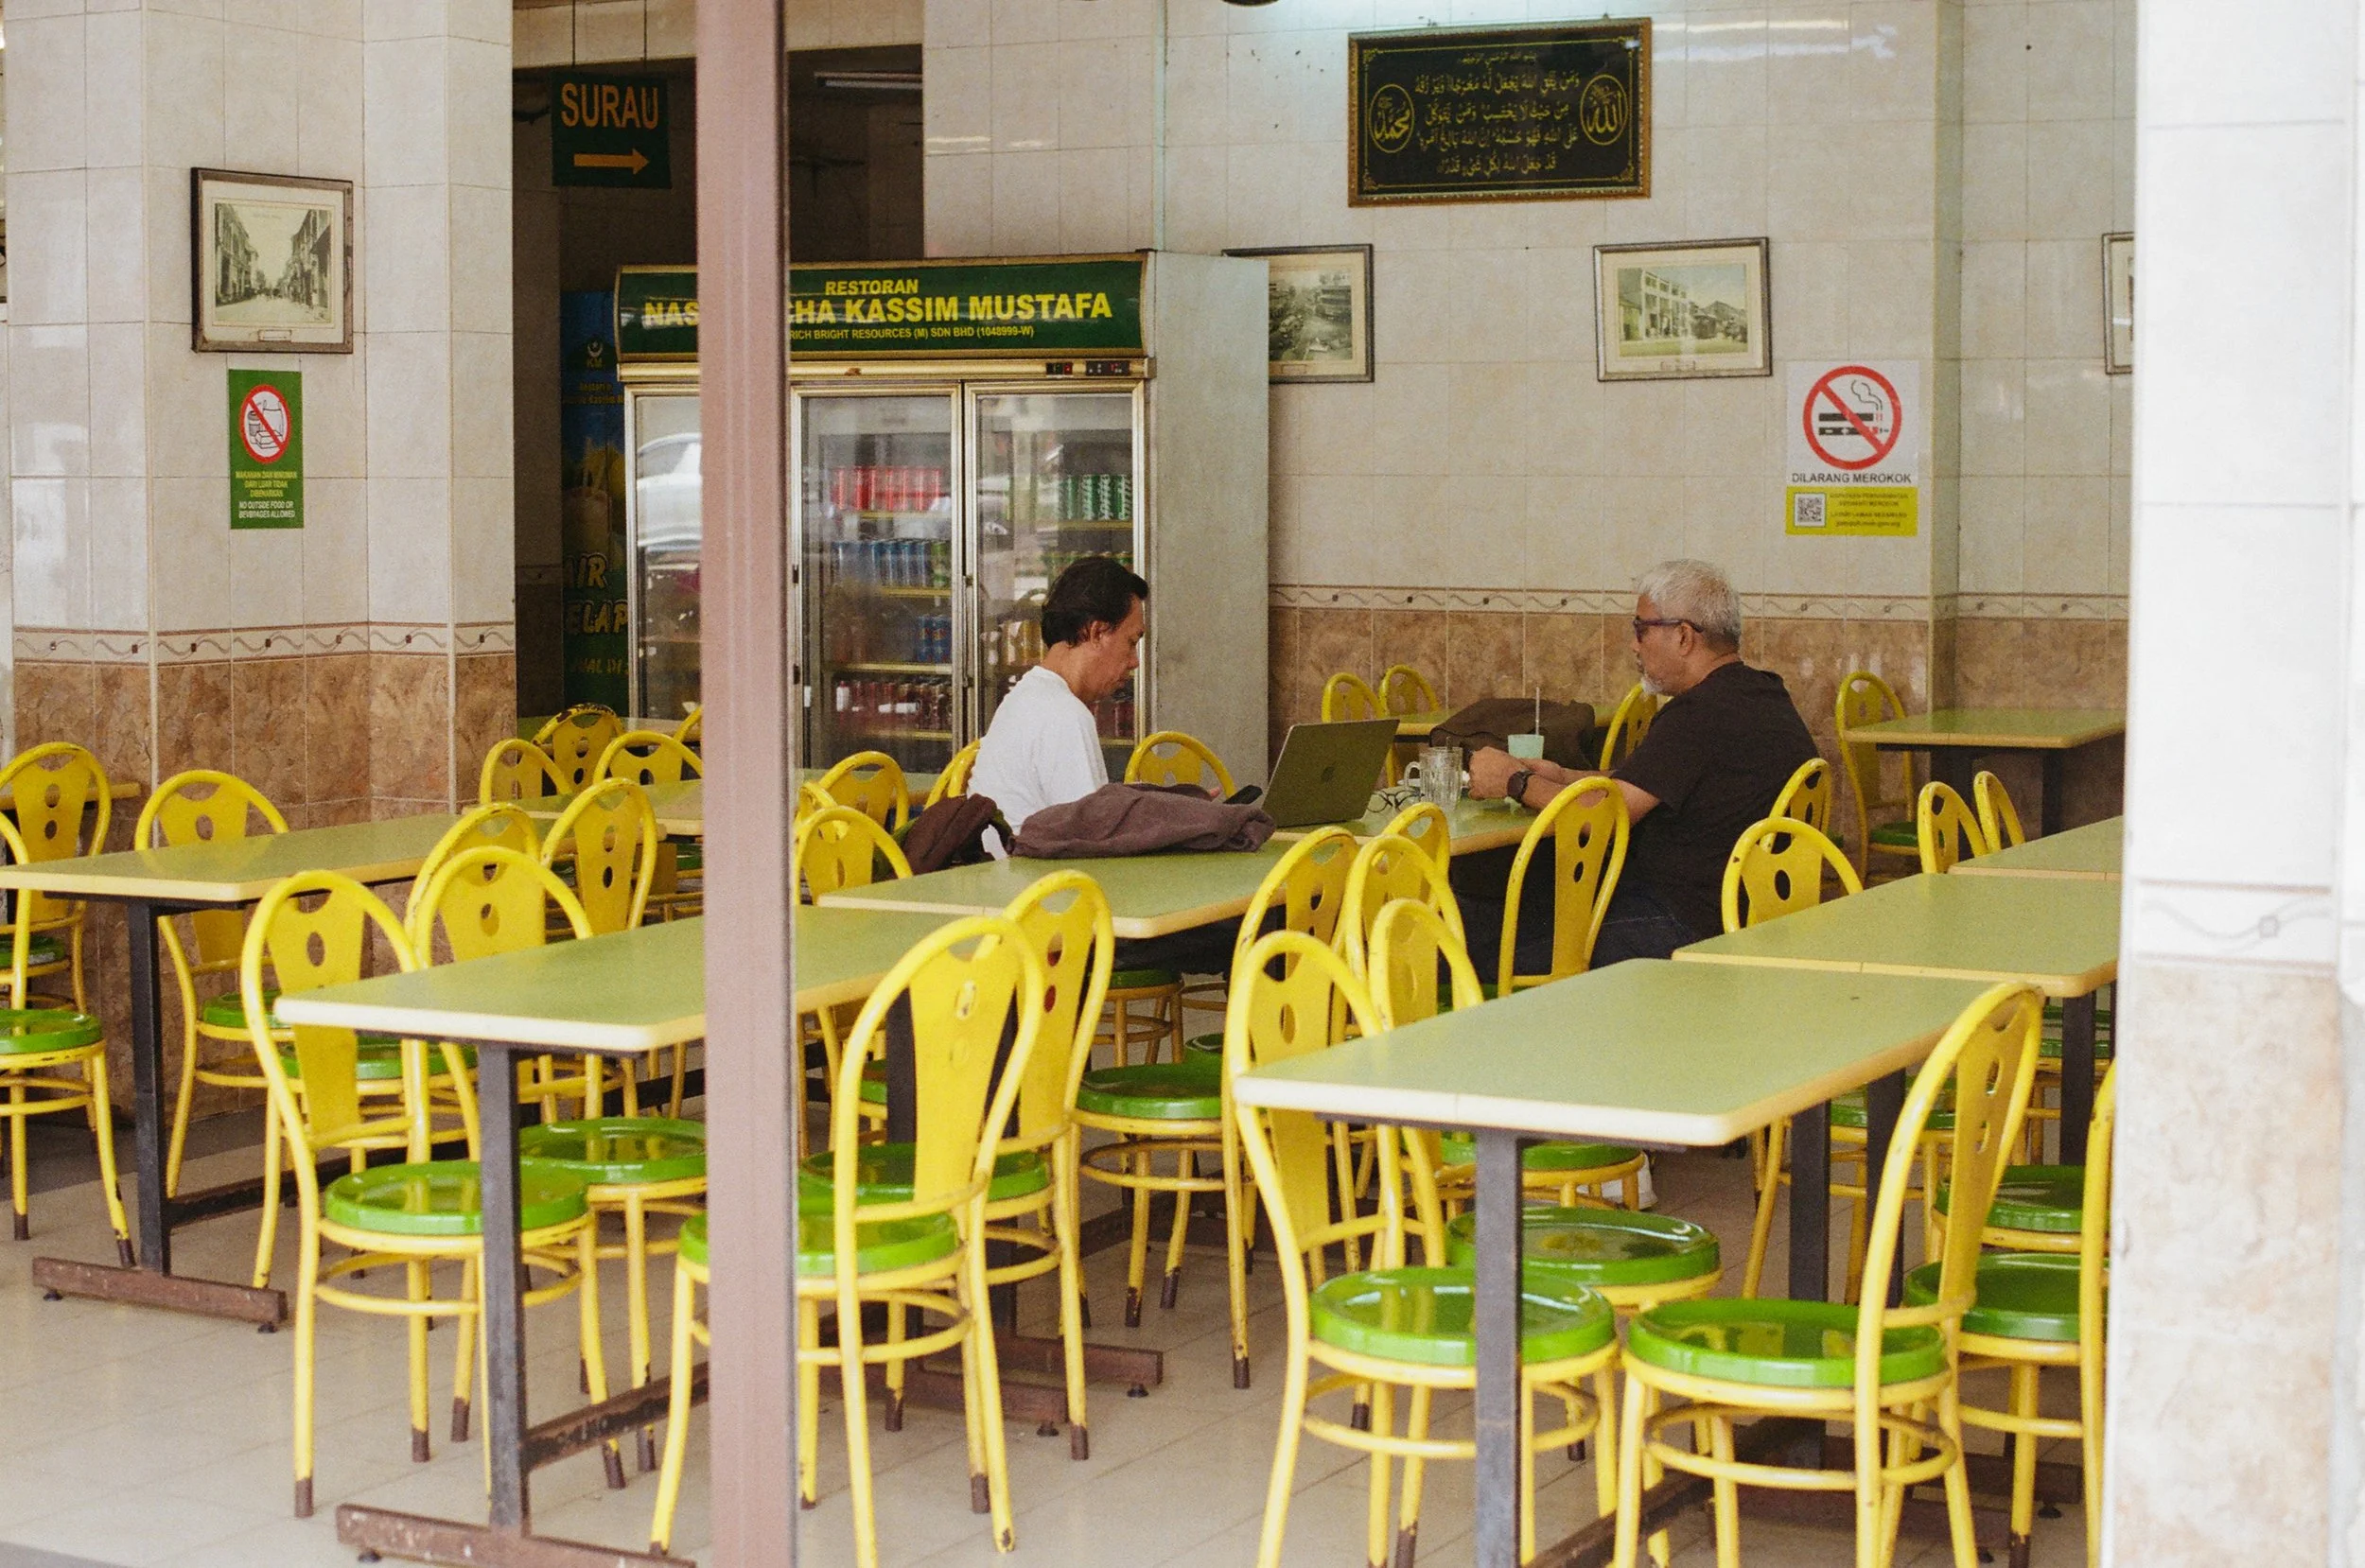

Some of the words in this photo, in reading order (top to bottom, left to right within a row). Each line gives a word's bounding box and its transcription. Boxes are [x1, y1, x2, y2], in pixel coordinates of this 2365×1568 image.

[561, 82, 659, 130] SURAU
[825, 279, 919, 295] RESTORAN
[643, 300, 698, 326] NAS
[845, 295, 958, 323] KASSIM
[969, 292, 1112, 322] MUSTAFA
[815, 329, 850, 340] BRIGHT
[853, 327, 911, 339] RESOURCES
[914, 327, 929, 340] (M)
[931, 327, 951, 338] SDN
[954, 326, 974, 337] BHD
[1792, 473, 1850, 483] DILARANG
[1852, 473, 1912, 483] MEROKOK
[238, 500, 247, 509] NO
[248, 500, 270, 509] OUTSIDE
[270, 500, 285, 509] FOOD
[286, 500, 294, 509] OR
[271, 510, 295, 518] ALLOWED
[567, 601, 628, 634] ELAP
